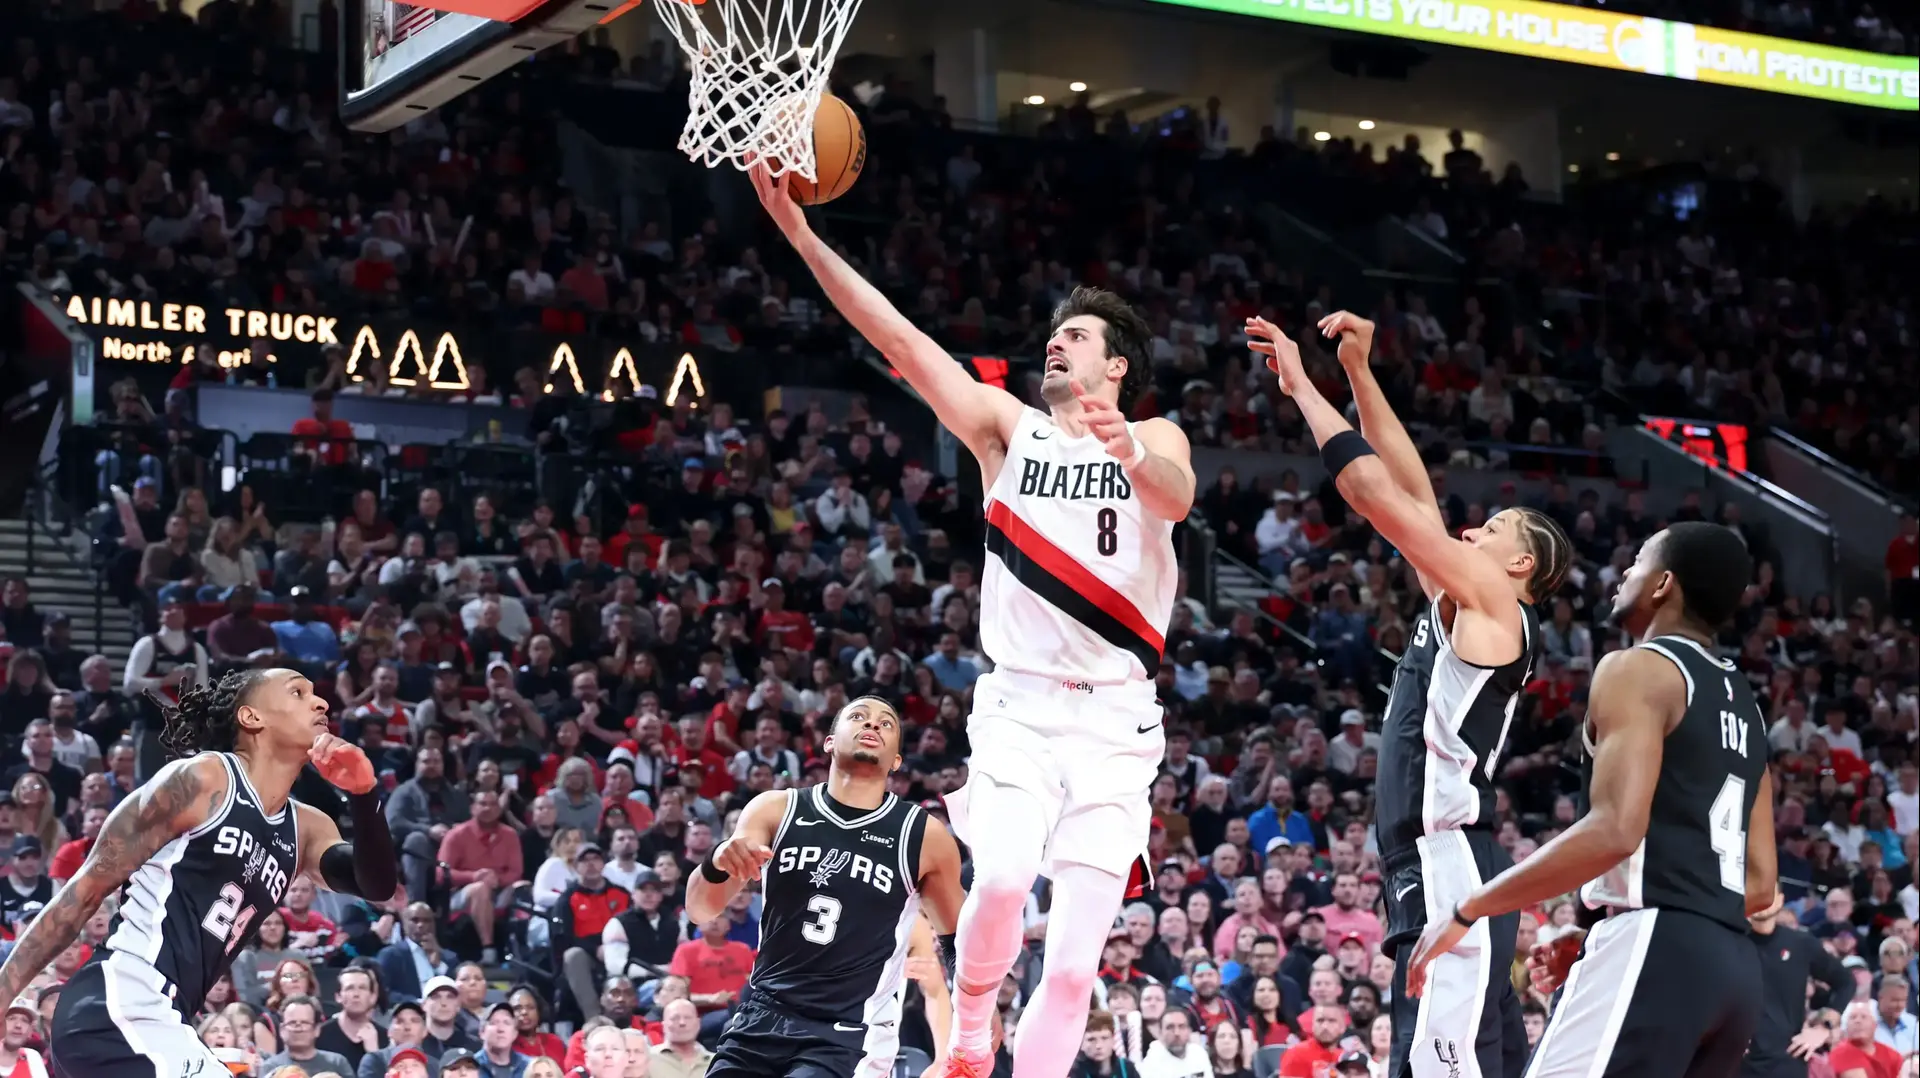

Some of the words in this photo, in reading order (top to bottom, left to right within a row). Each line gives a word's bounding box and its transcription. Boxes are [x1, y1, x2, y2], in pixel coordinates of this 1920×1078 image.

[1398, 0, 1490, 36] YOUR
[1497, 10, 1609, 53] HOUSE
[1766, 51, 1919, 98] PROTECTS
[66, 295, 206, 333] AIMLER
[225, 308, 338, 345] TRUCK
[103, 337, 171, 363] North
[1019, 457, 1131, 500] BLAZERS
[1097, 508, 1118, 556] 8
[1062, 680, 1094, 694] ripcity
[1720, 710, 1748, 758] FOX
[1708, 773, 1746, 895] 4
[201, 881, 258, 956] 24
[801, 894, 843, 945] 3
